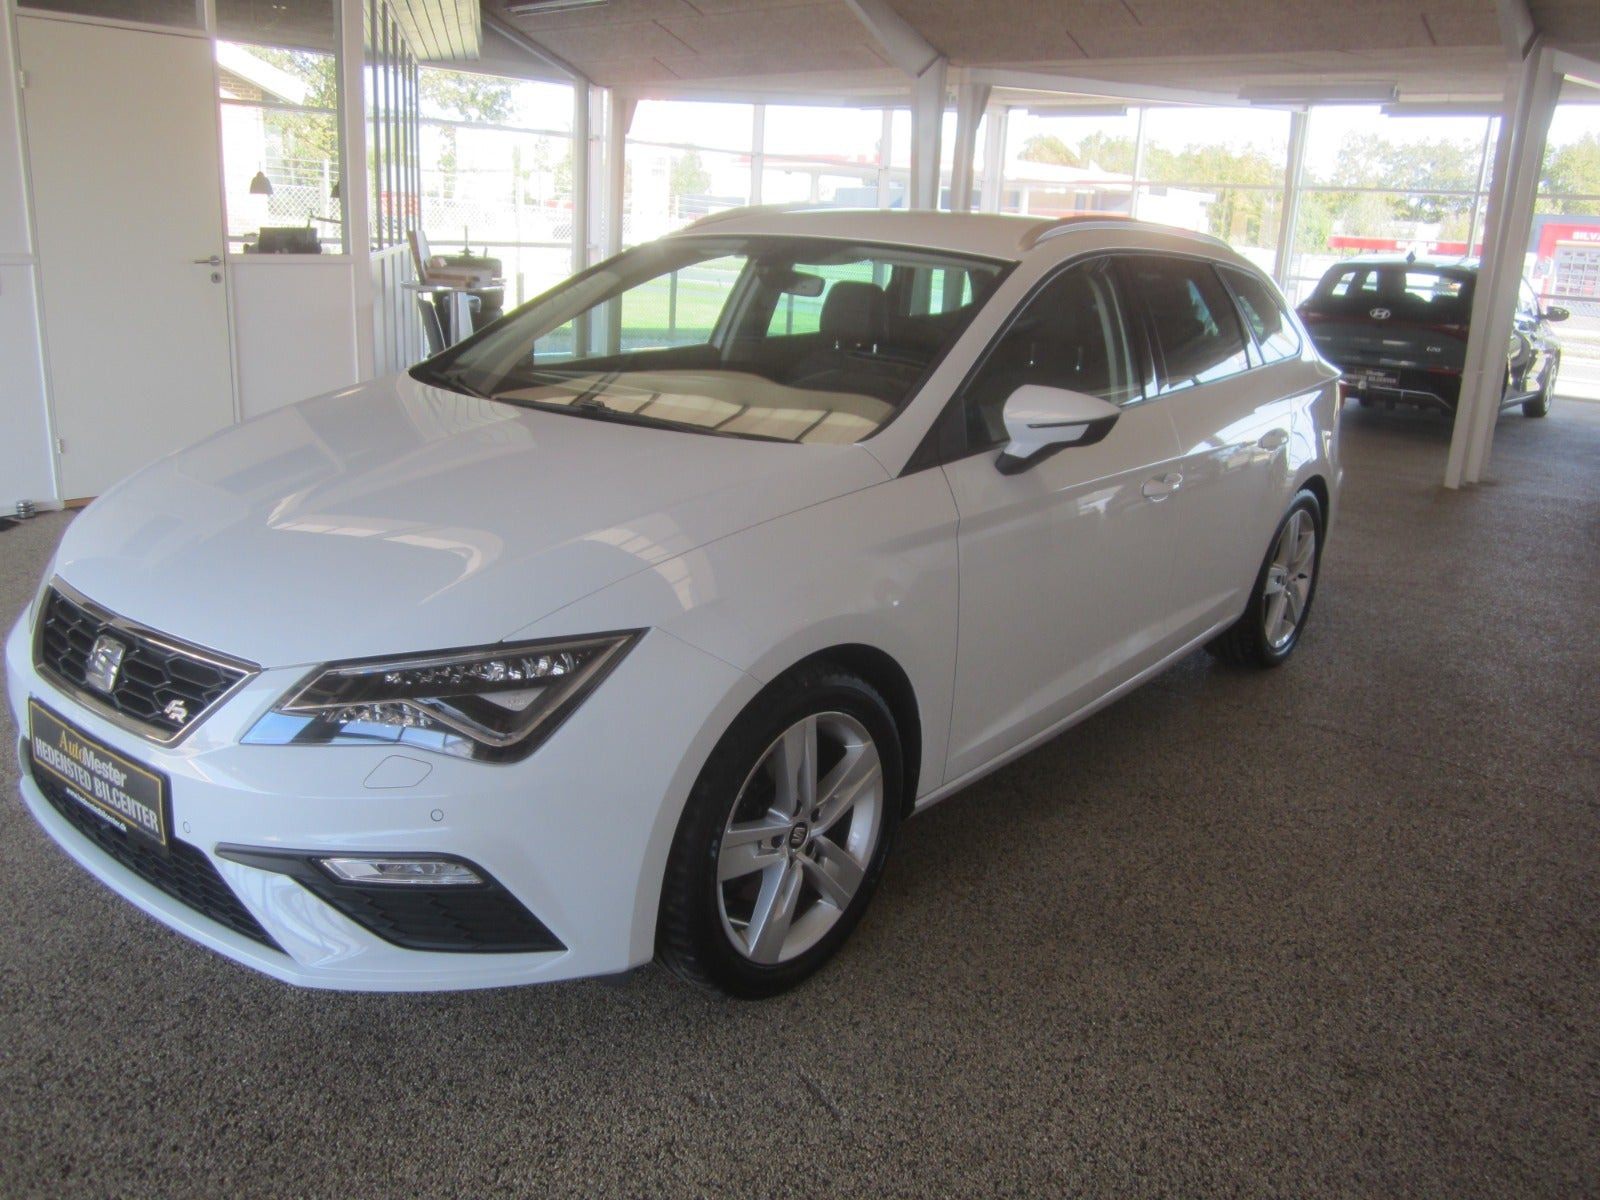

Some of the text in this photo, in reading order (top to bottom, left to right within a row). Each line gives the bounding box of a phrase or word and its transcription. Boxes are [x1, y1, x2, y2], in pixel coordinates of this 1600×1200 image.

[35, 735, 92, 791] HEDENSTED
[93, 776, 160, 833] BILCENTER
[58, 729, 128, 787] AutoMester
